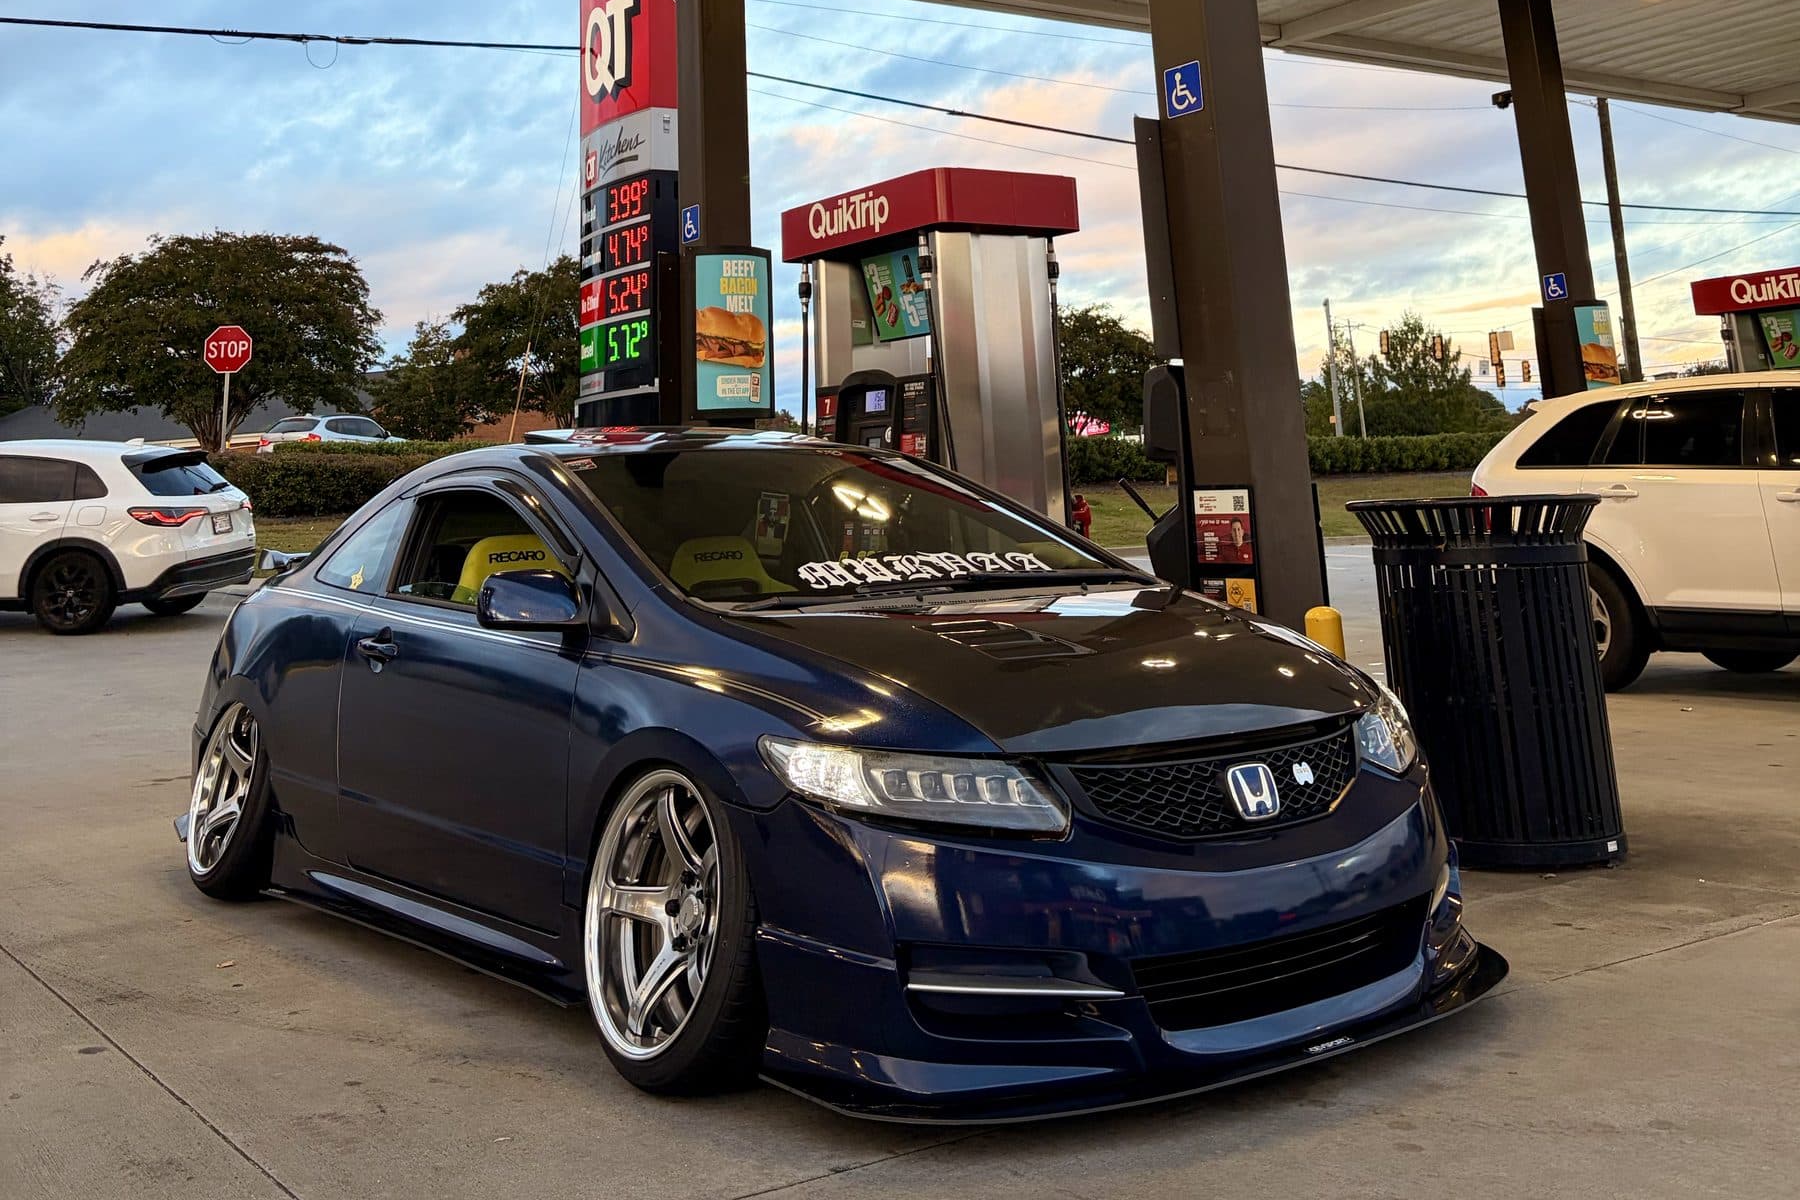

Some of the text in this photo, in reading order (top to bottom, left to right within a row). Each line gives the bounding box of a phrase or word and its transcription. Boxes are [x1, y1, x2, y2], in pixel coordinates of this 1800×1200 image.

[808, 191, 889, 239] QuikTrip
[722, 259, 755, 277] BEEFY
[720, 277, 757, 296] BACON
[726, 295, 754, 312] MELT
[207, 340, 249, 359] STOP
[488, 550, 546, 564] RECARO
[693, 550, 743, 562] RECARO
